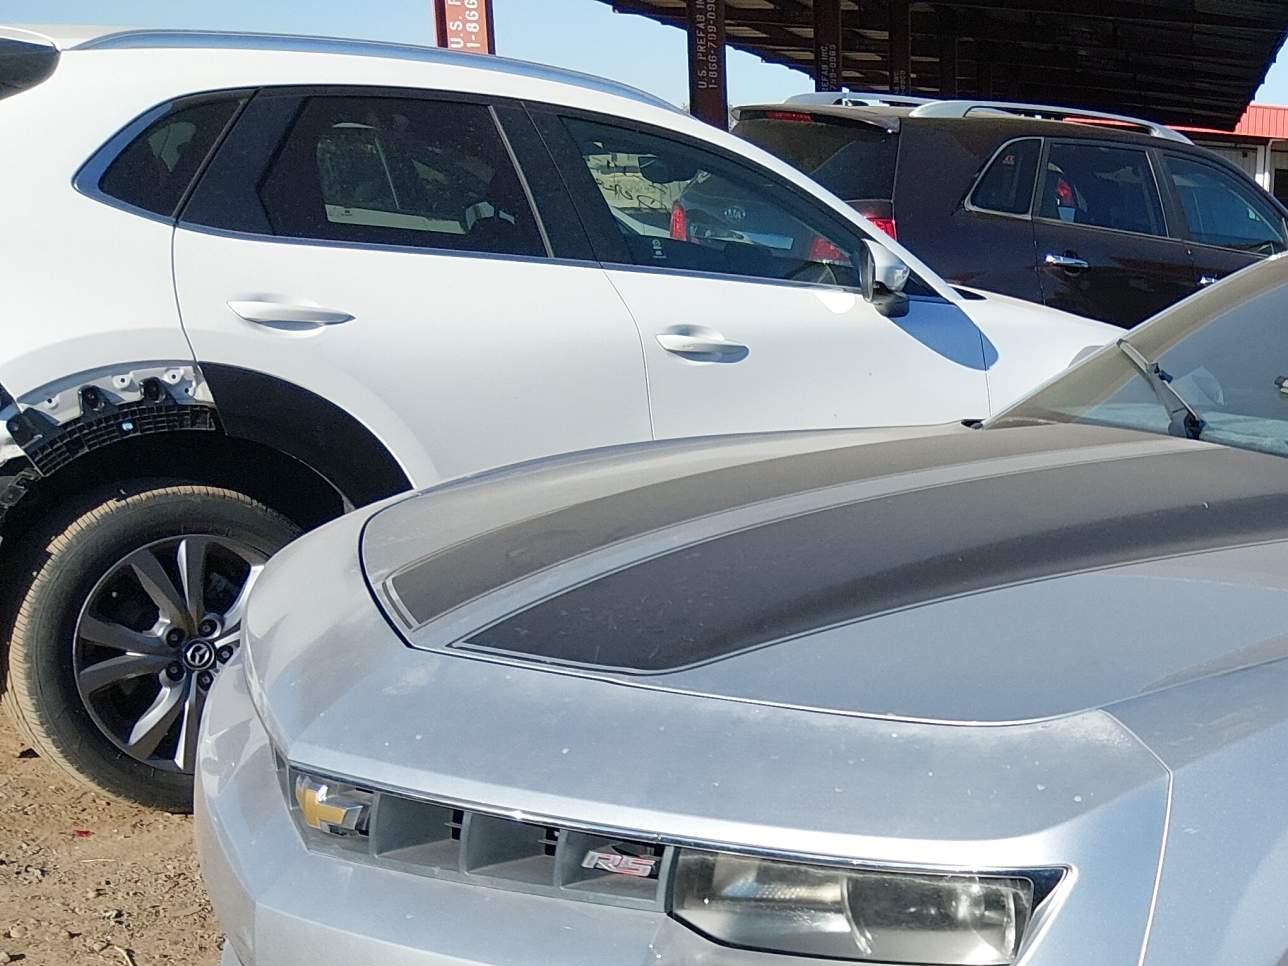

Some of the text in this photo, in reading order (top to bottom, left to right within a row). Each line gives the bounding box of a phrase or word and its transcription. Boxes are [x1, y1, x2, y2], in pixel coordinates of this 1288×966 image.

[449, 16, 464, 48] U.S.
[695, 14, 706, 60] PREFAB
[581, 850, 656, 878] RS
